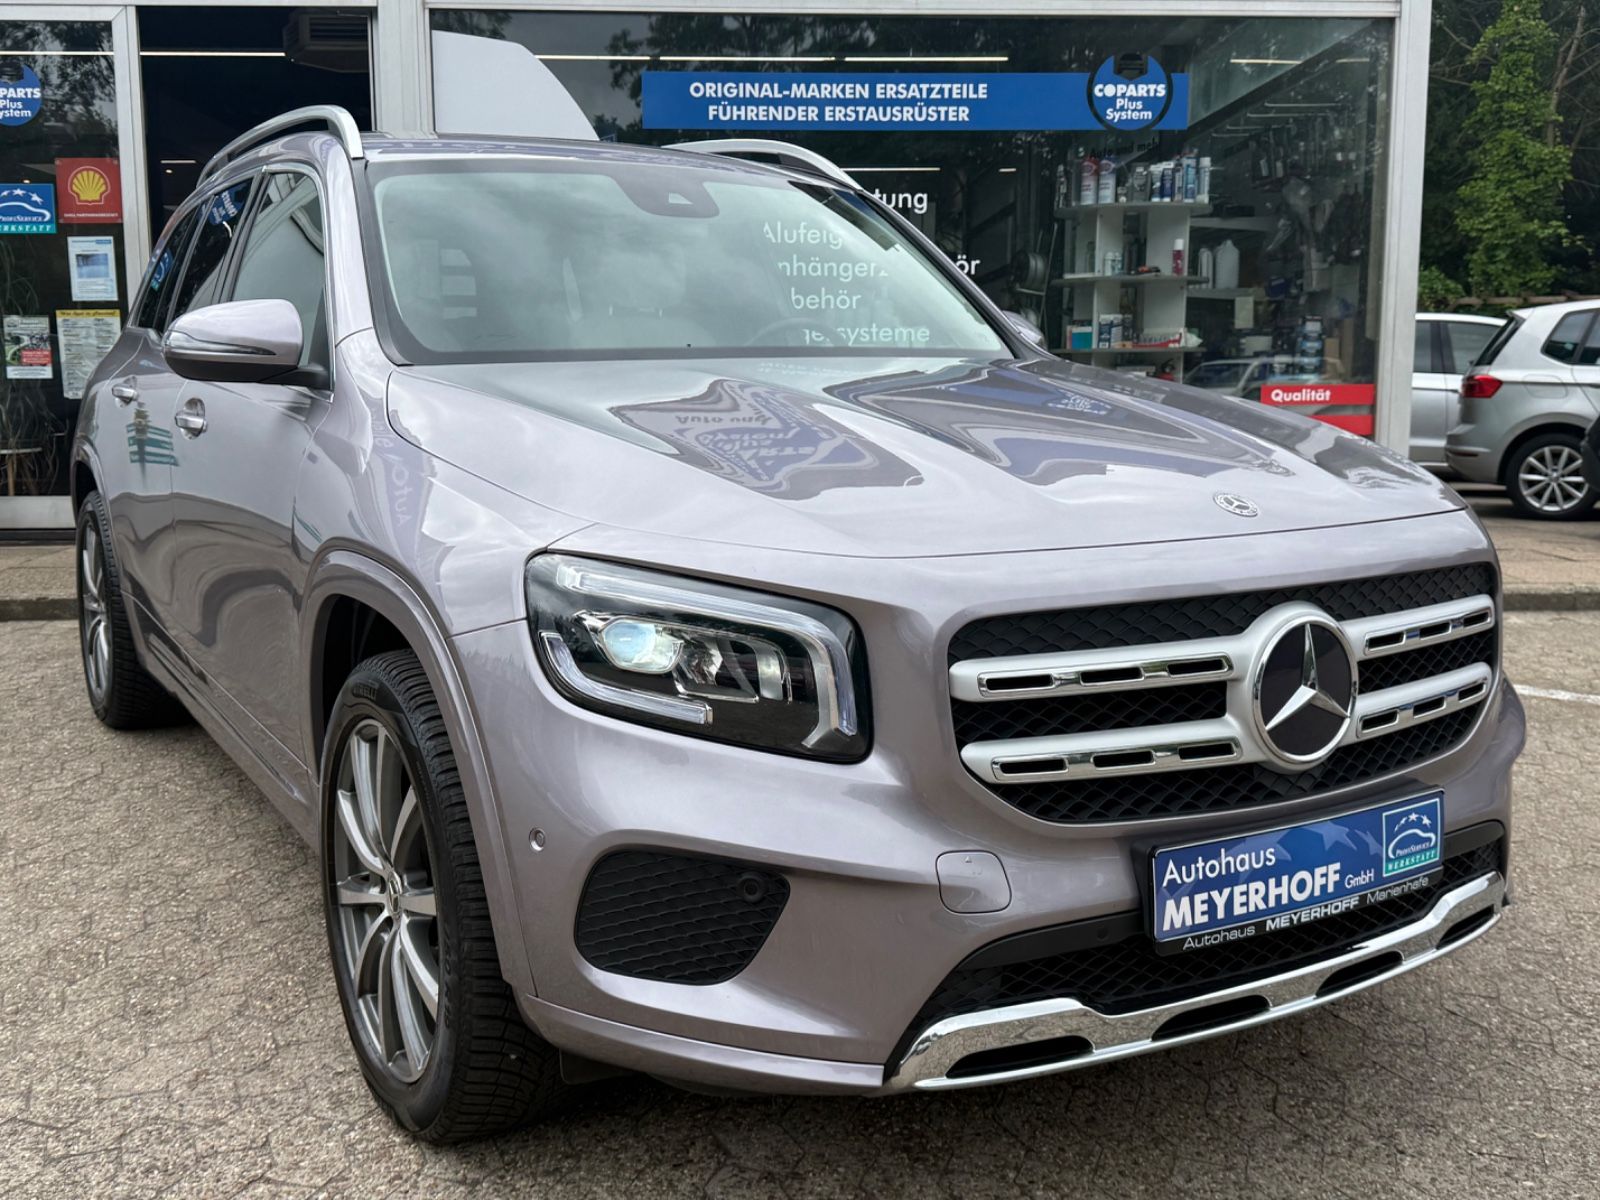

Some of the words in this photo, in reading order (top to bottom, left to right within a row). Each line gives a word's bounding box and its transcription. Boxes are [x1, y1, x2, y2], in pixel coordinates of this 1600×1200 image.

[689, 82, 869, 99] ORIGINAL-MARKEN
[875, 83, 988, 99] ERSATZTEILE
[1094, 84, 1167, 97] COPARTS
[708, 101, 819, 121] FÜHRENDER
[824, 102, 970, 122] ERSTAUSRÜSTER
[1116, 98, 1143, 110] Plus
[1106, 108, 1153, 122] System
[791, 287, 862, 310] behör
[1271, 388, 1331, 403] Qualität
[1162, 847, 1276, 888] Autohaus
[1387, 850, 1436, 871] WERKSTATT
[1162, 861, 1341, 932] MEYERHOFF
[1344, 868, 1375, 889] GmbH
[1182, 925, 1256, 951] Autohaus
[1265, 896, 1360, 932] MEYERHOFF
[1366, 875, 1429, 905] Marienhafe
